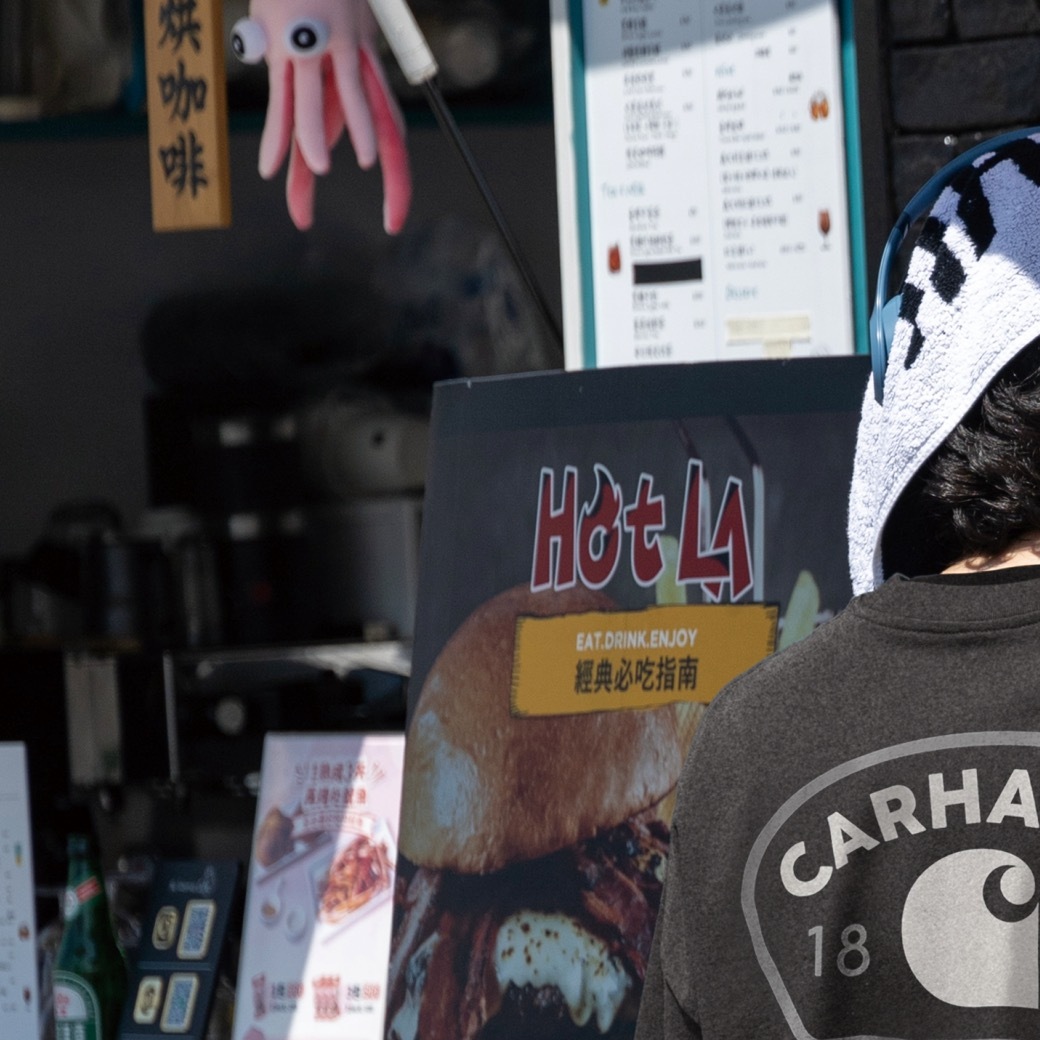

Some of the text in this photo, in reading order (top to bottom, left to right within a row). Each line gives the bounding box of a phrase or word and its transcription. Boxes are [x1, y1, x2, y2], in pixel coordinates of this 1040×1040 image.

[575, 628, 698, 651] EAT.DRINK.ENJOY
[573, 655, 699, 695] 經典必吃指南
[807, 923, 871, 977] 18
